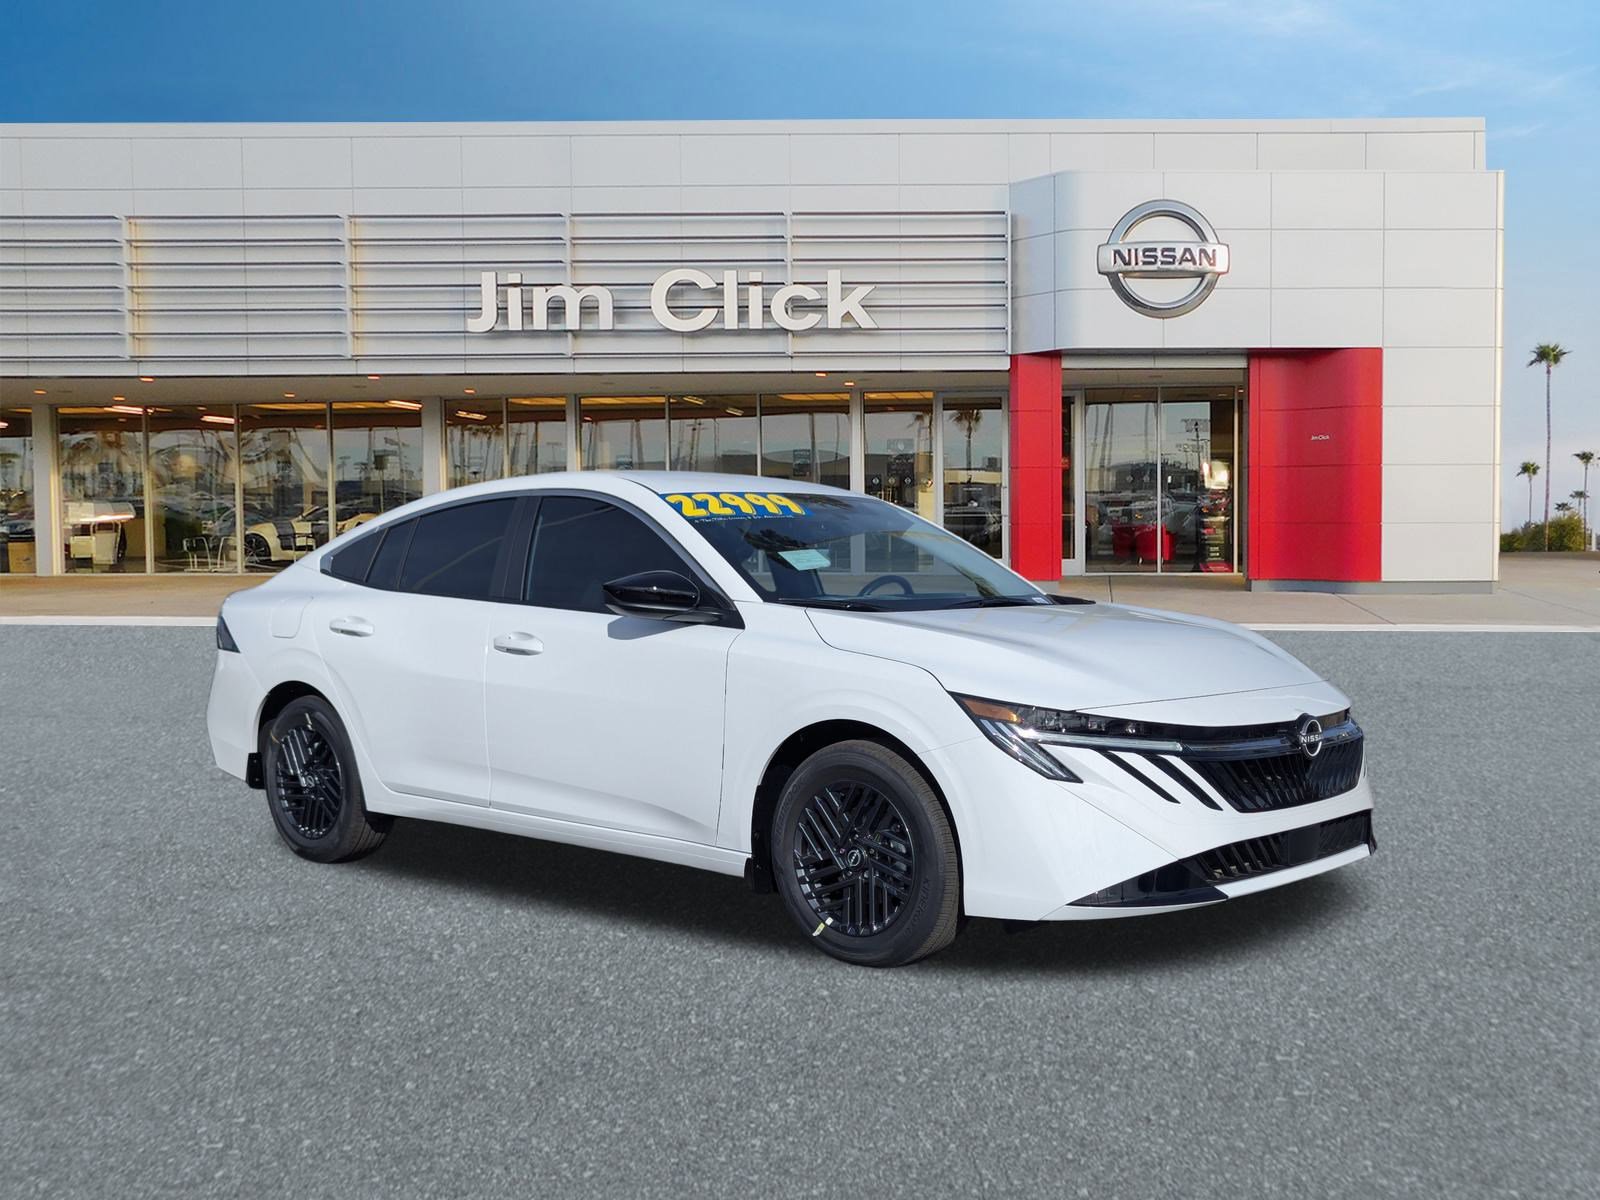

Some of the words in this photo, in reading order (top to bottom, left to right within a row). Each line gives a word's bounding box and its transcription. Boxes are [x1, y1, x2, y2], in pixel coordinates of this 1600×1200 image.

[1113, 247, 1217, 267] NISSAN
[466, 270, 614, 333] Jim
[650, 268, 879, 333] Click
[665, 493, 806, 517] 22999
[1301, 734, 1322, 744] NISS
